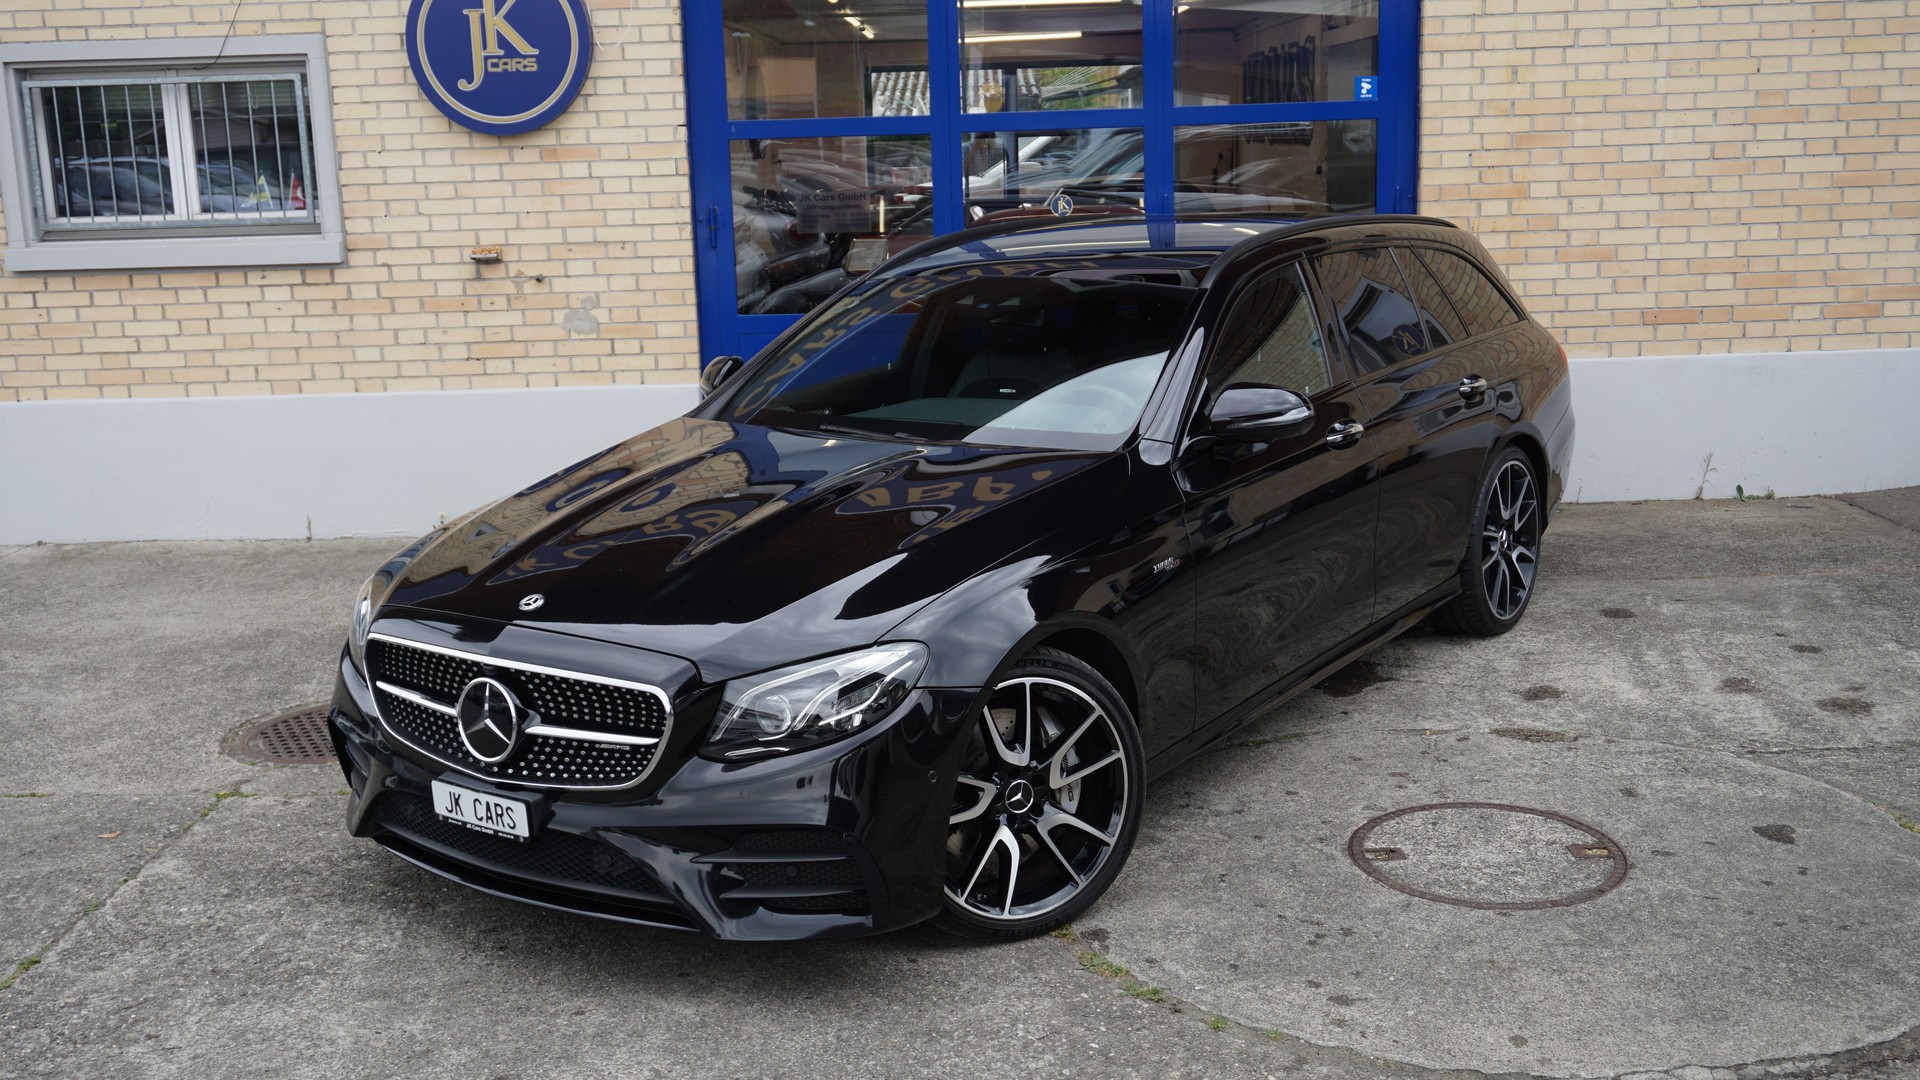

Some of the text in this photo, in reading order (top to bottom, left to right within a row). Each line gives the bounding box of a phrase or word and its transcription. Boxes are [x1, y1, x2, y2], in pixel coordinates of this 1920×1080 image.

[457, 0, 540, 91] JK
[486, 57, 538, 73] CARS
[799, 192, 867, 202] JK Cars GmbH
[445, 790, 517, 830] JK CARS
